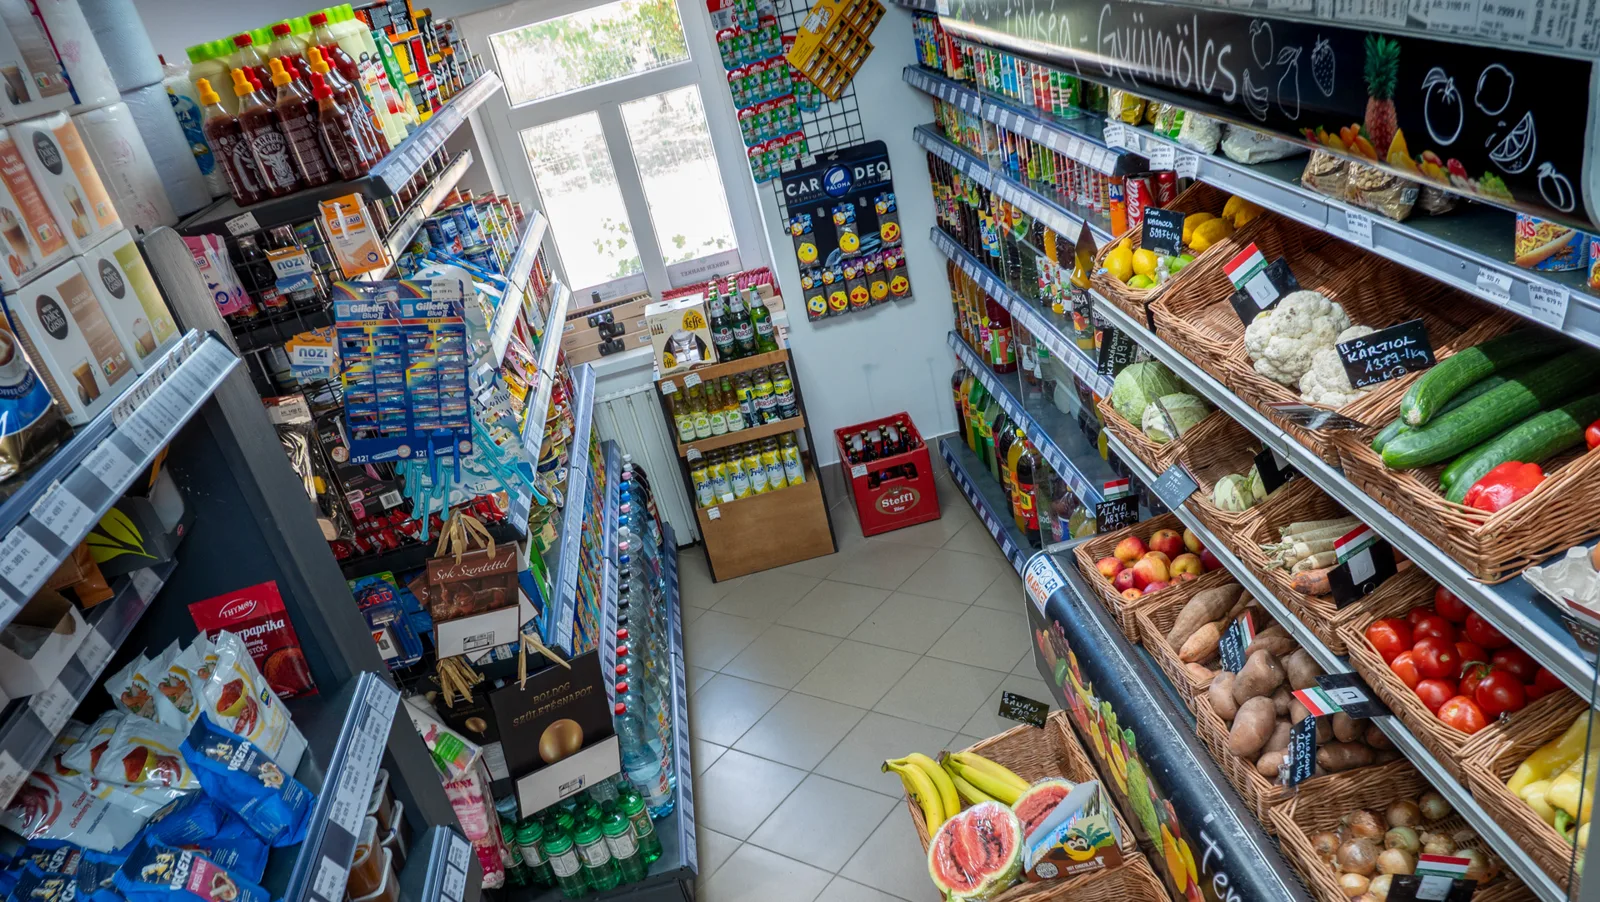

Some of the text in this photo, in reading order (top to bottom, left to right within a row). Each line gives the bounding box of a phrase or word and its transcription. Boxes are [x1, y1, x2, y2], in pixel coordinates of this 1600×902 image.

[1097, 4, 1237, 102] Gyümölcs
[786, 161, 888, 197] CAR DEO
[826, 182, 851, 192] PALOMA
[277, 259, 305, 271] nozi
[350, 304, 384, 314] Gillette
[416, 302, 449, 311] Gillette
[1546, 297, 1557, 305] 679
[299, 348, 328, 358] nozi
[881, 492, 914, 508] Steffl
[1099, 503, 1127, 516] ALMA
[433, 552, 516, 581] Sok Szeretettel
[222, 600, 253, 618] THYMOS
[209, 619, 286, 646] Ferpaprika
[533, 682, 571, 704] BOLDOG
[513, 686, 593, 727] SZÜLETÉSNAPOT
